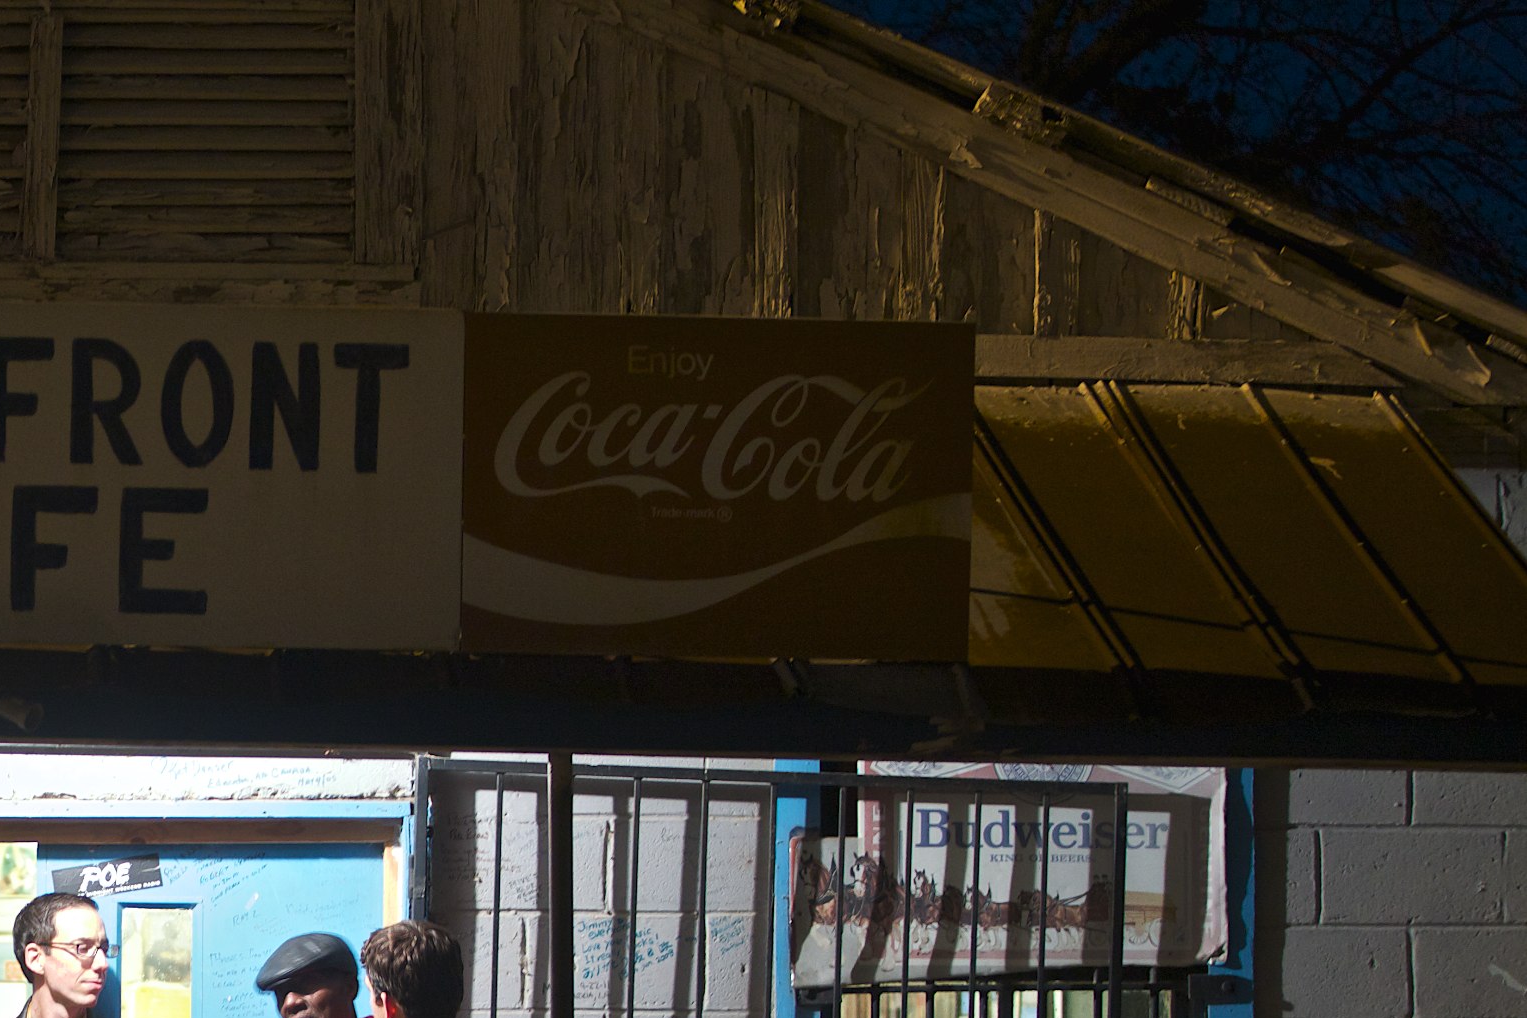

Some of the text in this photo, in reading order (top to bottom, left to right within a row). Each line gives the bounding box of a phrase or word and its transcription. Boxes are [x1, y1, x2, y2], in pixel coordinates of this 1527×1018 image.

[627, 345, 714, 381] Enjoy
[494, 370, 936, 502] Coca-Cola
[915, 809, 1164, 850] Budweiser
[990, 855, 1024, 863] KING
[1051, 854, 1095, 863] BEERS
[78, 861, 132, 893] POE
